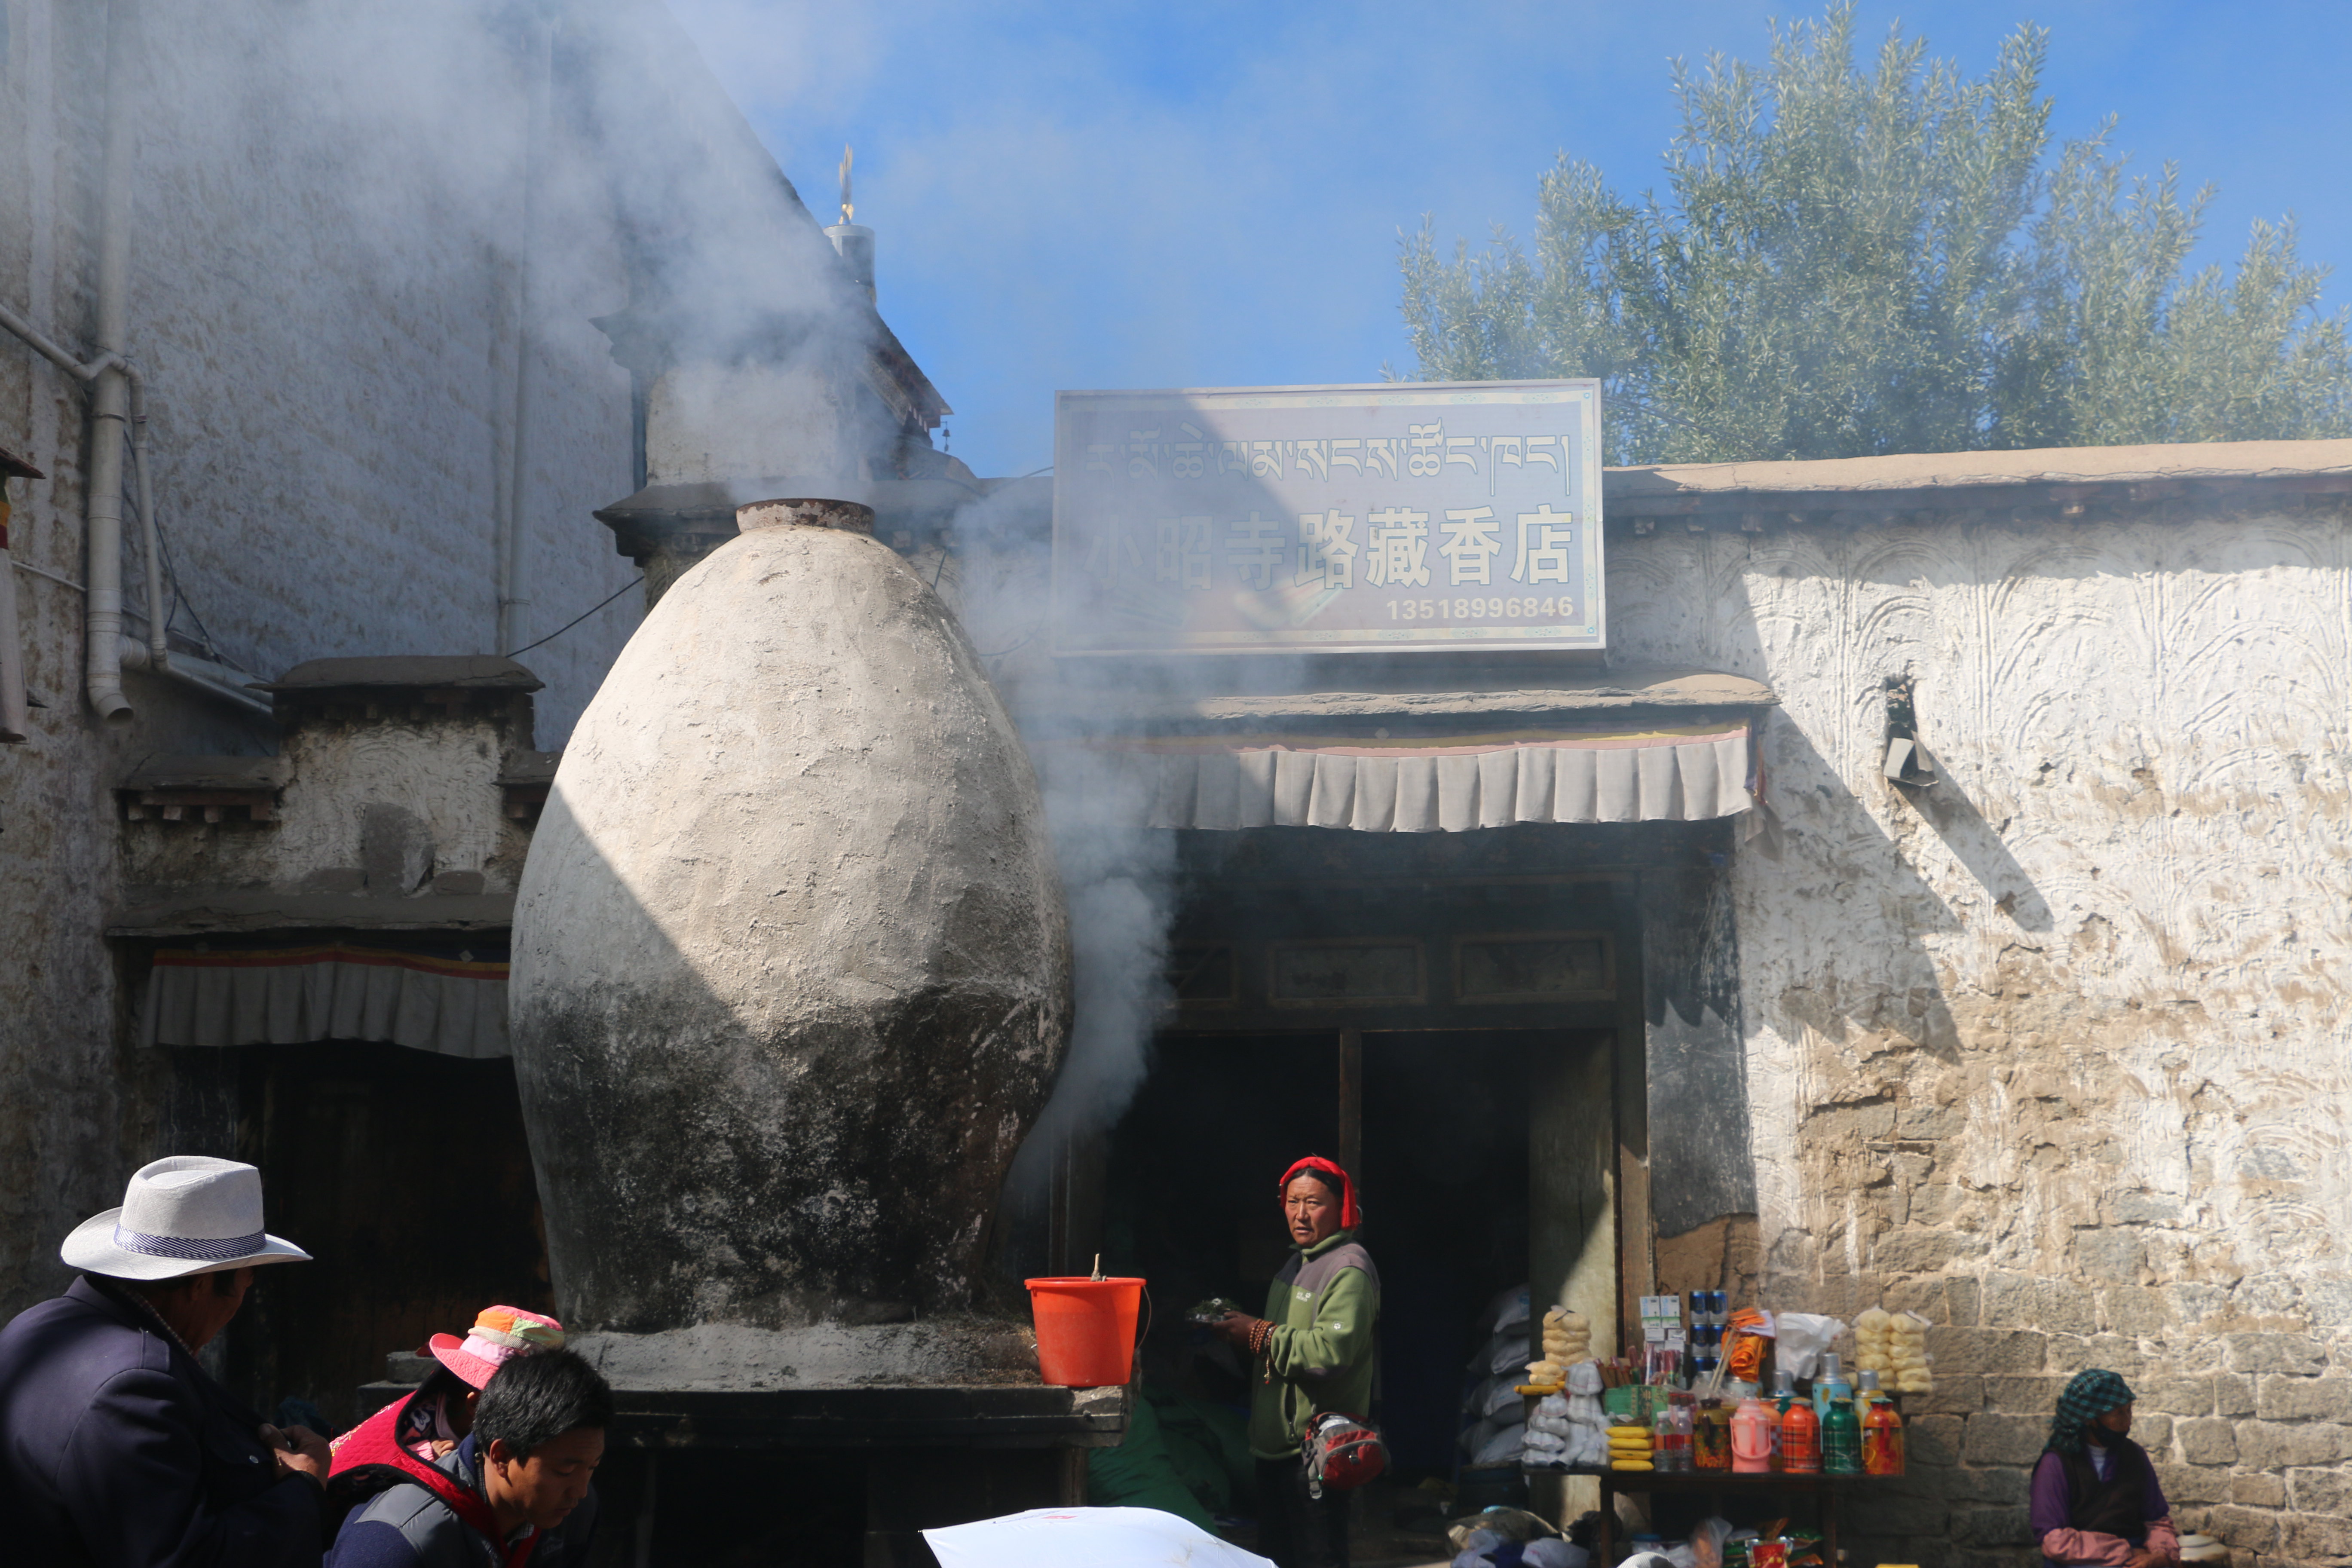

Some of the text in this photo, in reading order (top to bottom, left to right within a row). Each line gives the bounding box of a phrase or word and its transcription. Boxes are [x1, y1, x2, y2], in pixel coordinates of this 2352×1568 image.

[1082, 504, 1573, 590] 小昭寺路藏香店
[1387, 596, 1574, 620] 13518996846
